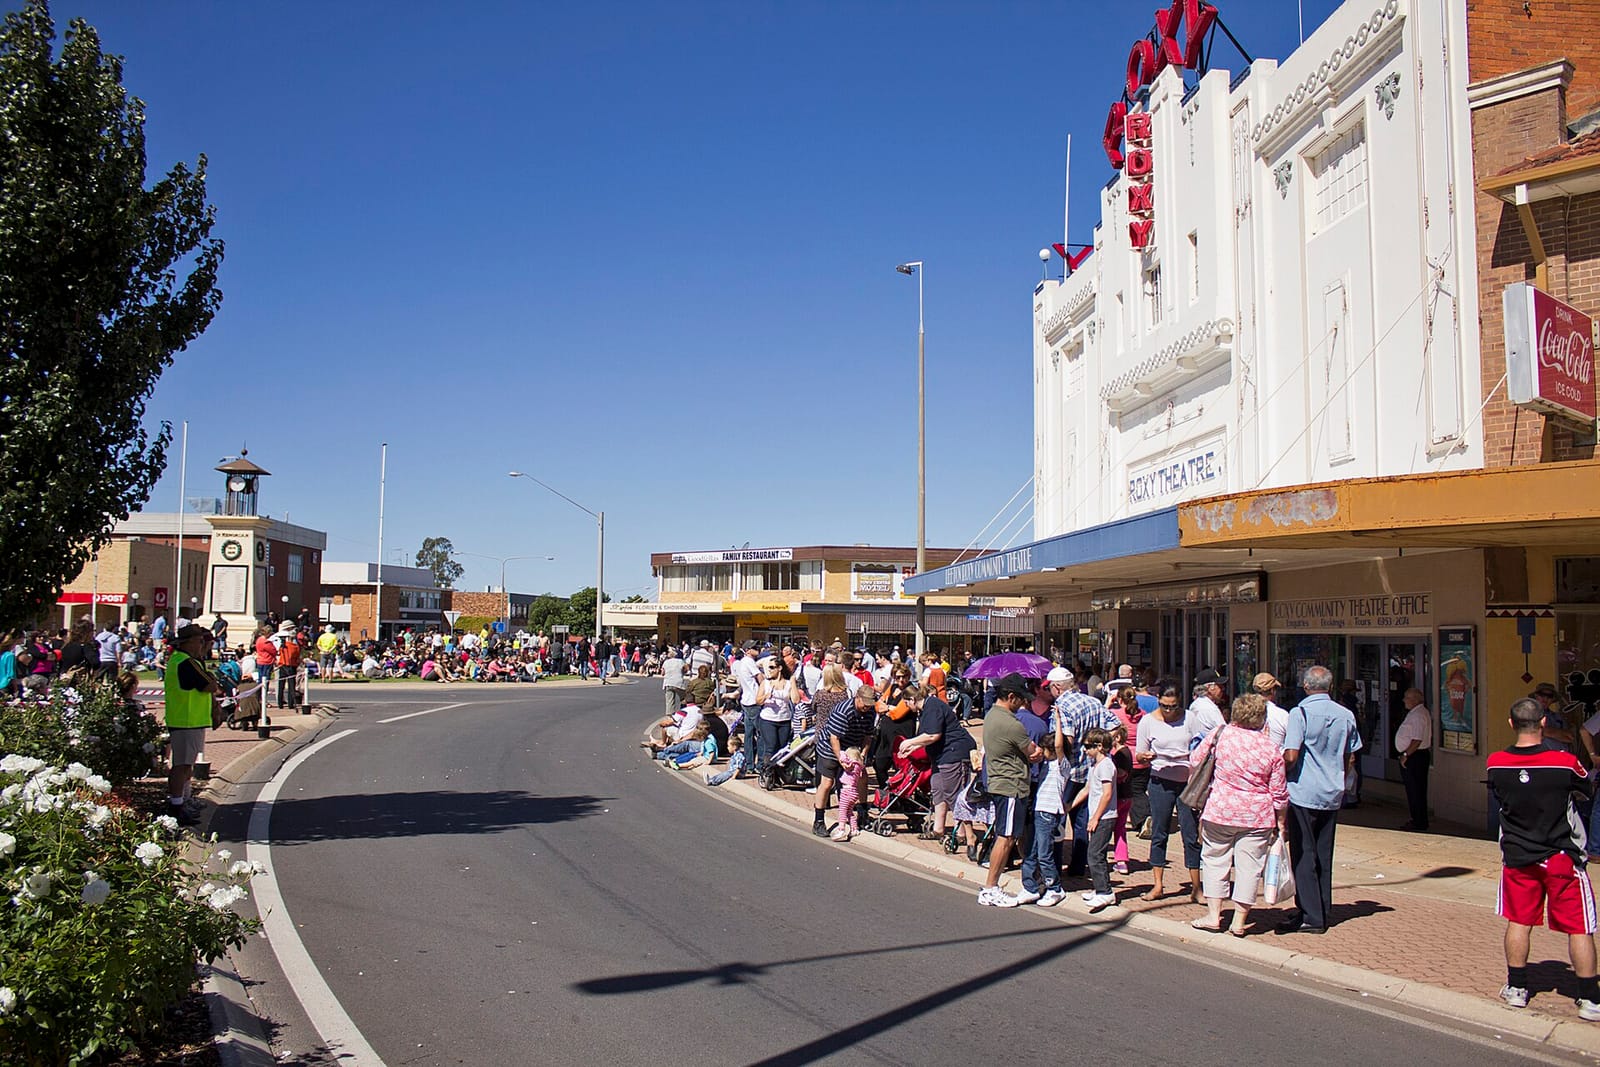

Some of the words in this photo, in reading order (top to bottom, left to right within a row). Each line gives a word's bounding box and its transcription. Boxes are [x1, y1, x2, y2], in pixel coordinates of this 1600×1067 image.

[1126, 112, 1154, 249] ROXY
[1555, 306, 1573, 325] DRINK
[1539, 318, 1591, 385] Coca-Cola
[1555, 381, 1565, 396] ICE
[1565, 385, 1581, 402] COLD
[1129, 471, 1156, 504] ROXY
[1158, 451, 1215, 496] THEATRE
[722, 552, 741, 561] FAMILY
[742, 550, 779, 560] RESTAURANT
[975, 555, 1004, 579] COMMUNITY
[1007, 547, 1033, 573] THEATRE
[1003, 607, 1026, 615] FASHION
[1295, 600, 1346, 618] COMMUNITY
[1349, 597, 1389, 617] THEATRE
[1392, 595, 1429, 615] OFFICE
[1354, 617, 1371, 626] Tours
